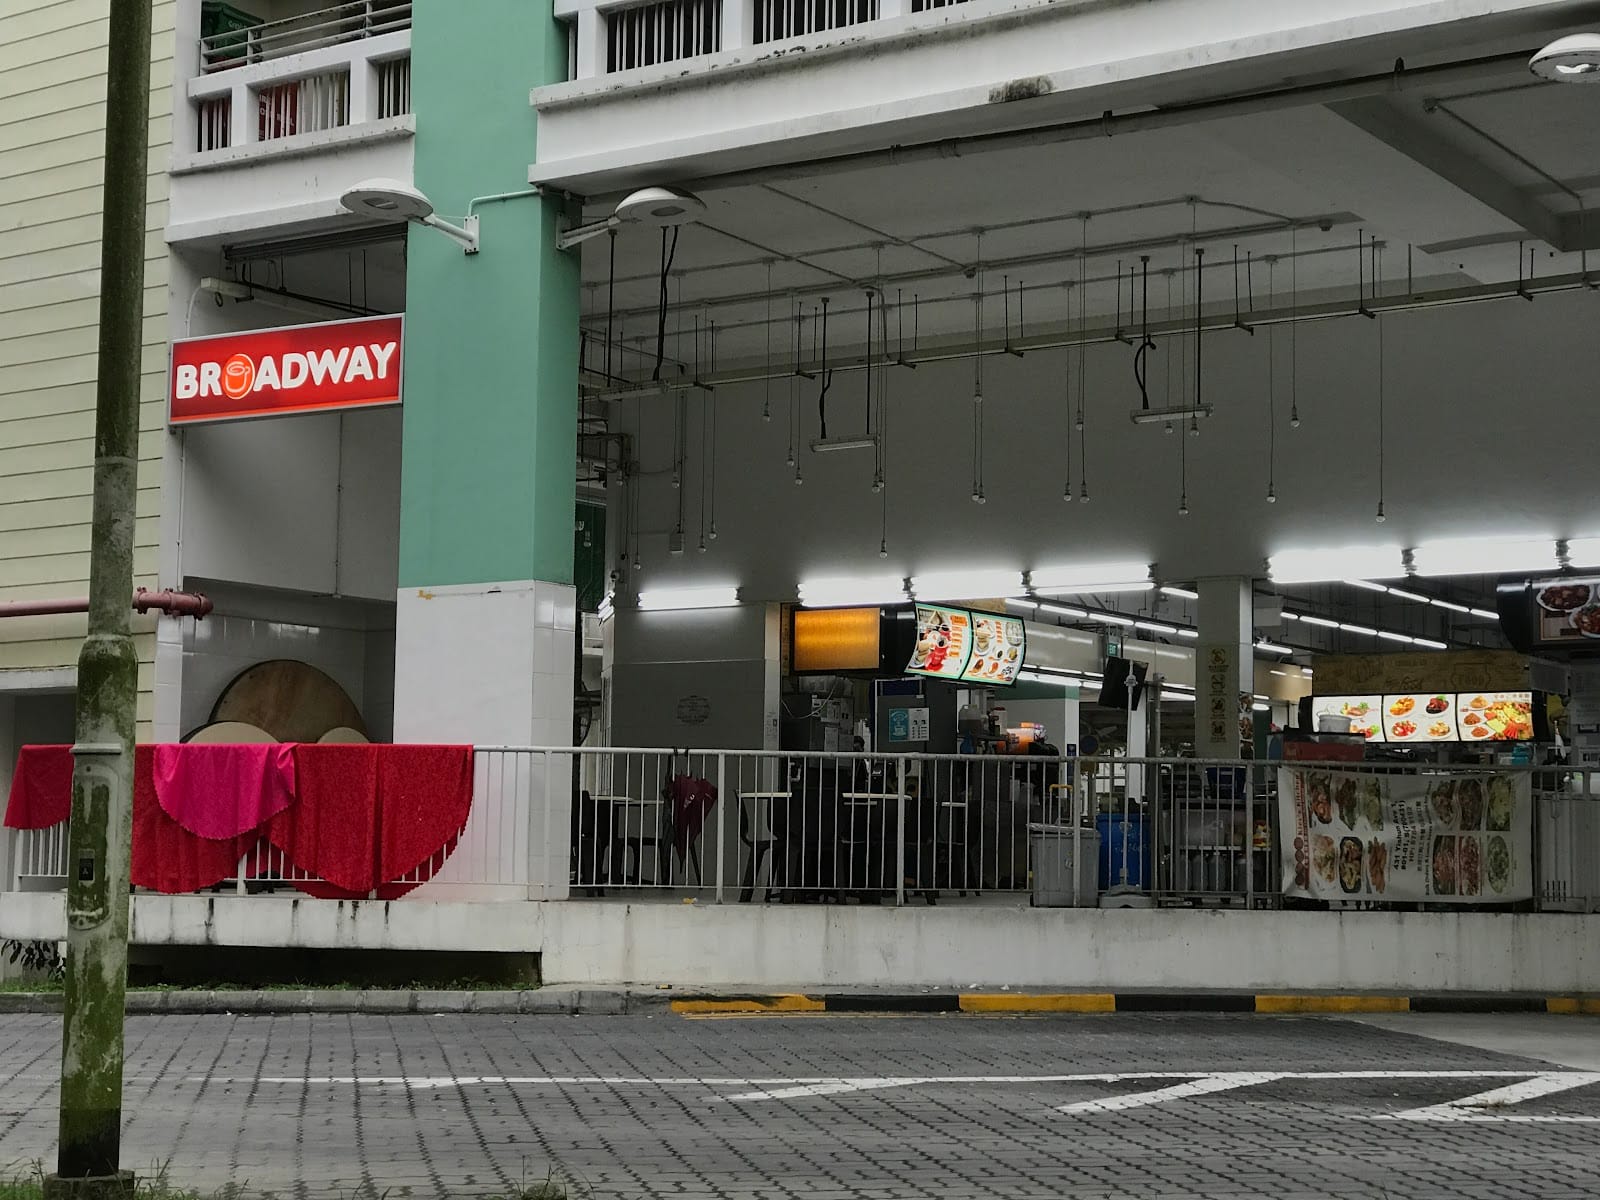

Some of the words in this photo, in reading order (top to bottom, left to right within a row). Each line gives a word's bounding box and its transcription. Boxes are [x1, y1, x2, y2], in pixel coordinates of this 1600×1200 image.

[176, 341, 397, 400] BROADWAY
[1394, 826, 1402, 852] Yishun
[1393, 855, 1401, 871] 431
